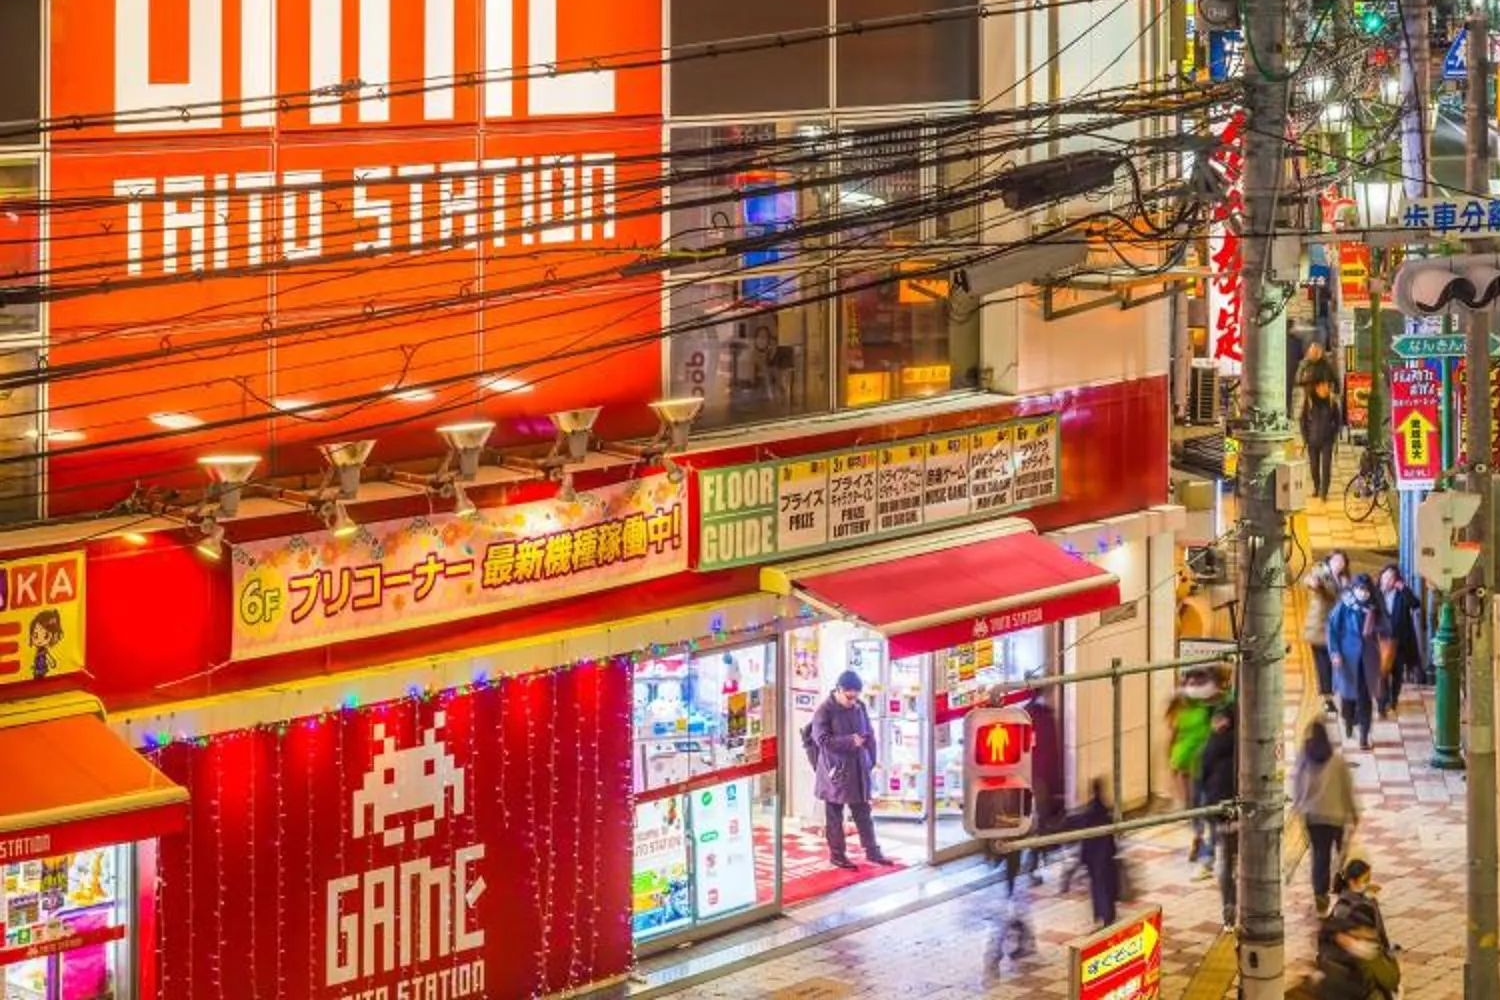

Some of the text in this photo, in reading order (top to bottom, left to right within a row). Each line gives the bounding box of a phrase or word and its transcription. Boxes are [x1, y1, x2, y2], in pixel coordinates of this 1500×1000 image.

[114, 153, 616, 277] TAITO STATION
[703, 466, 775, 514] FLOOR
[781, 487, 825, 513] プライズ
[481, 504, 682, 589] 最新機種稼働中!
[703, 516, 775, 563] GUIDE
[789, 511, 815, 531] PRIZE
[240, 558, 473, 625] 6F プリコーナー
[326, 843, 487, 987] GAME
